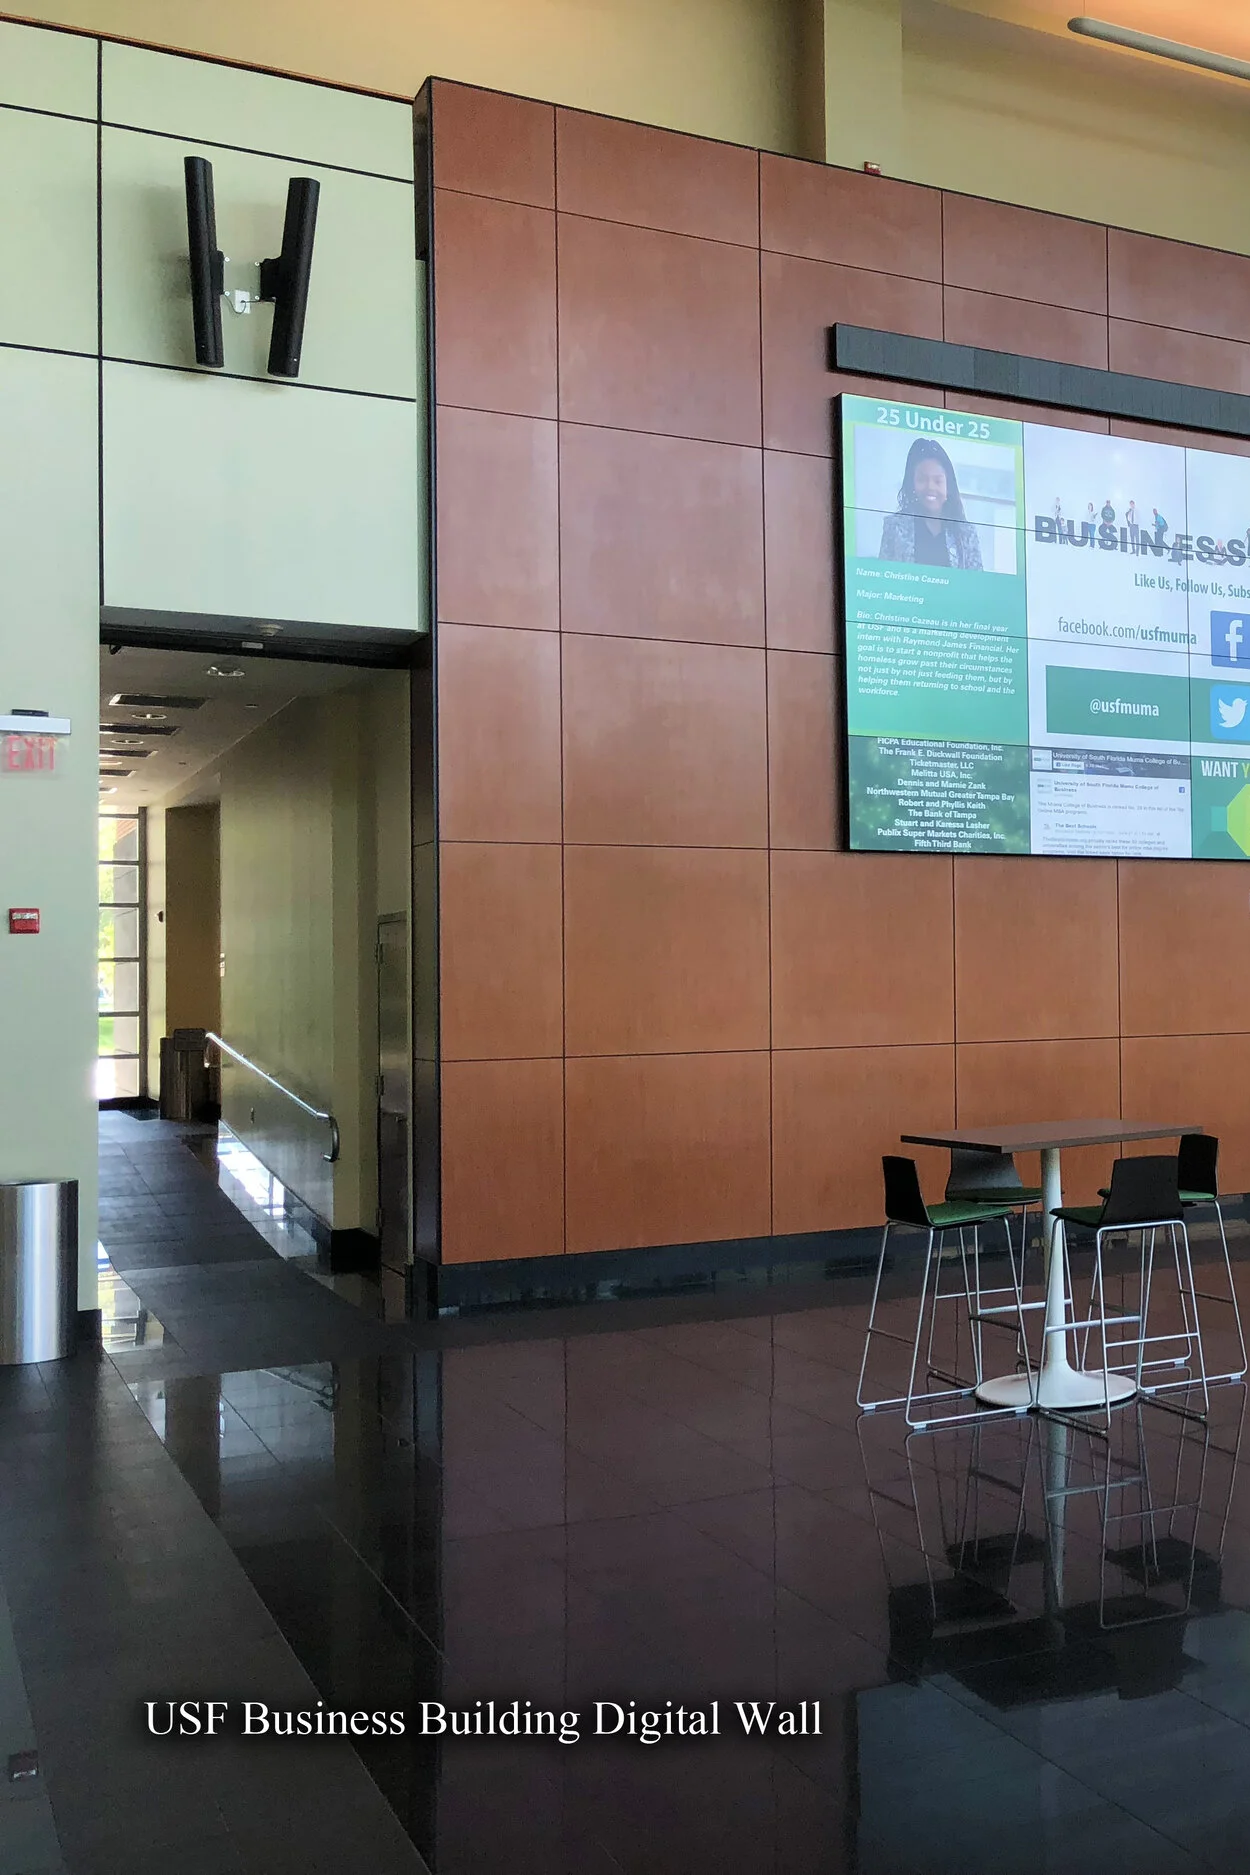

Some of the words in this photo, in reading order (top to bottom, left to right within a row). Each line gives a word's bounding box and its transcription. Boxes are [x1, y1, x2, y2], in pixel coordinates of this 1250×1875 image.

[877, 407, 900, 424] 25
[906, 411, 963, 435] Under
[968, 421, 990, 439] 25
[884, 571, 919, 581] Christine
[921, 575, 949, 585] Cazeau
[1134, 574, 1155, 588] Like
[1158, 576, 1173, 592] Us,
[1176, 578, 1208, 594] Follow
[1211, 583, 1226, 597] Us,
[857, 590, 882, 600] Major:
[884, 592, 924, 604] Marketing
[1058, 617, 1197, 645] facebook.com/usfmuma
[903, 636, 940, 647] Raymond
[942, 640, 967, 649] James
[1006, 646, 1019, 654] Her
[858, 655, 896, 663] homeless
[920, 659, 937, 669] past
[959, 663, 1012, 673] circumstances
[1090, 698, 1159, 716] @usfmuma
[901, 739, 945, 748] Educational
[7, 736, 57, 770] EXIT
[879, 747, 893, 755] The
[895, 749, 916, 757] Frank
[962, 752, 1002, 761] Foundation
[911, 769, 937, 777] Melitta
[960, 771, 972, 779] Inc.
[1201, 760, 1238, 778] WANT
[898, 779, 923, 787] Dennis
[925, 780, 939, 788] and
[968, 782, 986, 790] Zank
[867, 787, 919, 797] Northwestern
[921, 790, 947, 798] Mutual
[949, 791, 977, 800] Greater
[977, 792, 1000, 801] Tampa
[1002, 793, 1014, 802] Bay
[898, 799, 924, 807] Robert
[926, 800, 939, 808] and
[942, 800, 965, 810] Phyllis
[967, 801, 985, 809] Keith
[908, 809, 922, 817] The
[924, 810, 943, 818] Bank
[945, 811, 953, 819] of
[953, 811, 976, 819] Tampa
[895, 819, 918, 828] Stuart
[920, 820, 934, 828] and
[877, 829, 901, 837] Publix
[903, 829, 925, 838] Super
[927, 830, 957, 838] Markets
[953, 840, 971, 849] Bank
